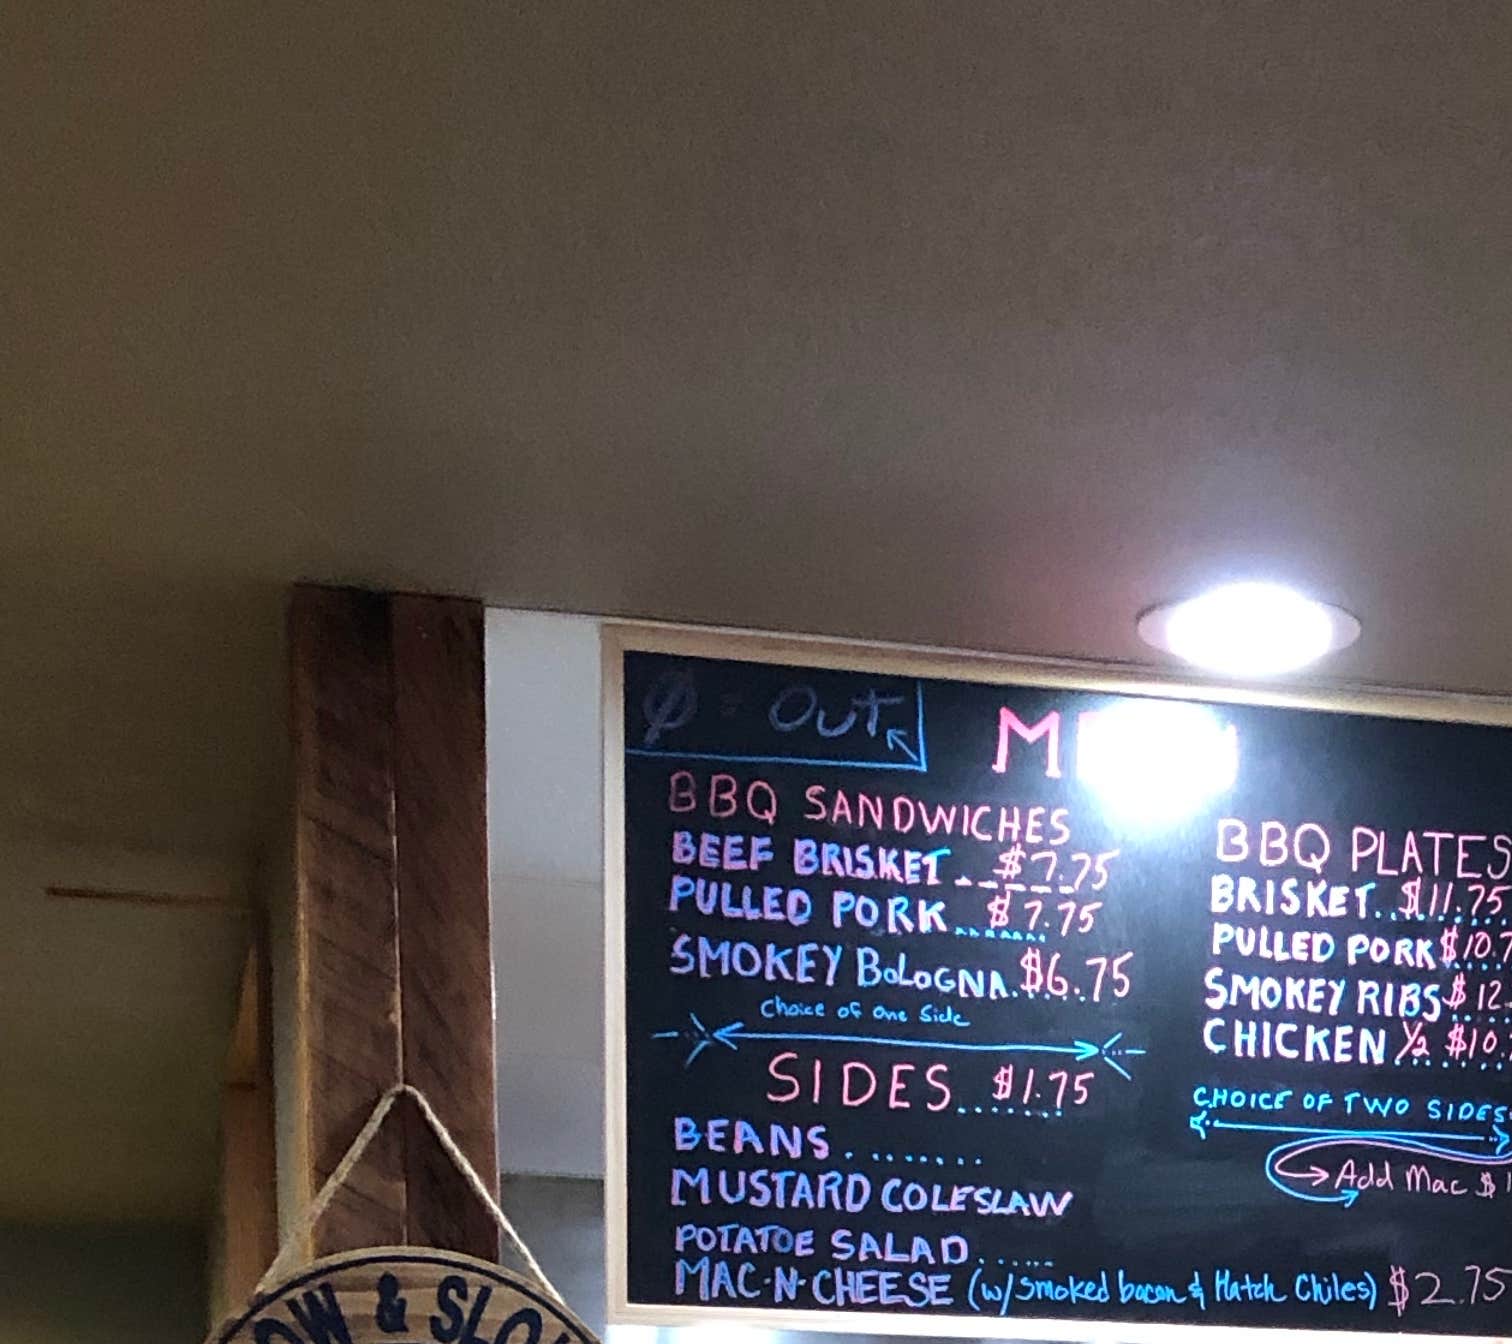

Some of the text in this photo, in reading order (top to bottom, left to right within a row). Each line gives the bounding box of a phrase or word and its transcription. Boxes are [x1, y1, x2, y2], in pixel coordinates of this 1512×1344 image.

[669, 771, 1071, 844] BBQ SANDWICHES
[672, 831, 1121, 891] BEEF BRISKET $7.75
[1216, 818, 1512, 880] BBQ PLATES
[669, 875, 1103, 935] PULLED PORK $7.75
[1210, 874, 1376, 919] BRISKET
[670, 934, 843, 986] SMOKEY
[1019, 946, 1135, 1001] $6.75
[1211, 921, 1335, 964] PULLED
[1347, 933, 1436, 970] PORK
[760, 995, 824, 1018] Choice
[837, 1001, 862, 1019] of
[1204, 966, 1346, 1014] SMOKEY
[1358, 980, 1441, 1022] RIBS
[1203, 1017, 1386, 1065] CHICKEN
[766, 1051, 1095, 1110] SIDES $1.75
[1193, 1087, 1509, 1124] CHOICE OF TWO SIDES
[674, 1117, 830, 1159] BEANS
[670, 1168, 1074, 1219] MUSTARD COLESLAW
[1335, 1159, 1393, 1191] Add
[1406, 1165, 1468, 1196] Mac
[675, 1223, 968, 1265] POTATOE SALAD
[375, 1271, 408, 1333] &
[1117, 1269, 1187, 1305] bacon
